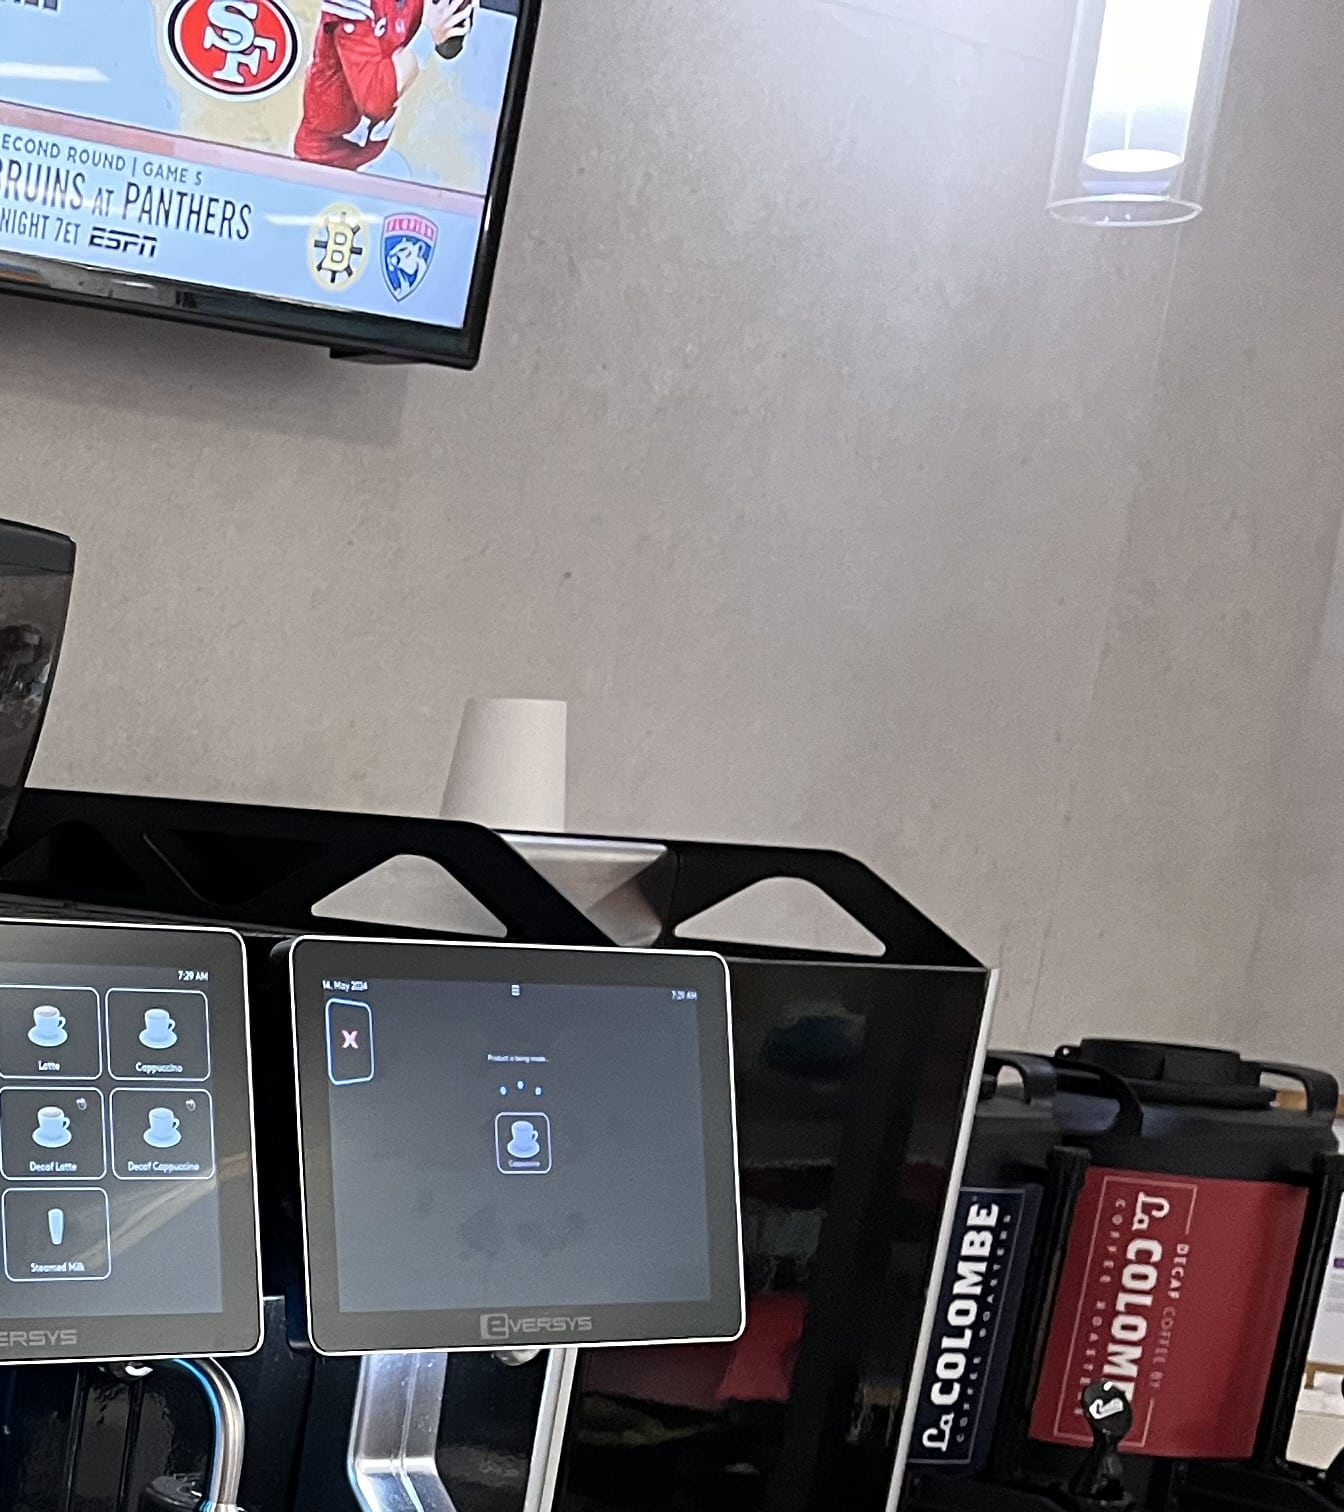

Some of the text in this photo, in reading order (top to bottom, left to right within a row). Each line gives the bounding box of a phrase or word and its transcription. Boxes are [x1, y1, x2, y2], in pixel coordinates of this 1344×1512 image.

[66, 146, 126, 173] ROUND
[142, 161, 188, 185] GAME
[193, 170, 203, 187] 5
[91, 186, 115, 219] AT
[121, 181, 253, 242] PANTHERS
[87, 226, 159, 258] ESPN
[195, 970, 209, 982] AM
[37, 1059, 61, 1072] Latte
[135, 1061, 184, 1075] Cappuccino
[29, 1160, 78, 1172] Decaf Latte
[127, 1161, 200, 1174] Decaf Cappuccino
[1099, 1198, 1126, 1284] COFFEE
[30, 1261, 85, 1273] Steamed Milk
[1168, 1242, 1190, 1300] DECAF
[1102, 1191, 1170, 1403] La COLOM
[921, 1203, 1000, 1453] La COLOMBE
[1153, 1305, 1176, 1364] COFFEE
[955, 1356, 982, 1443] COFFEE
